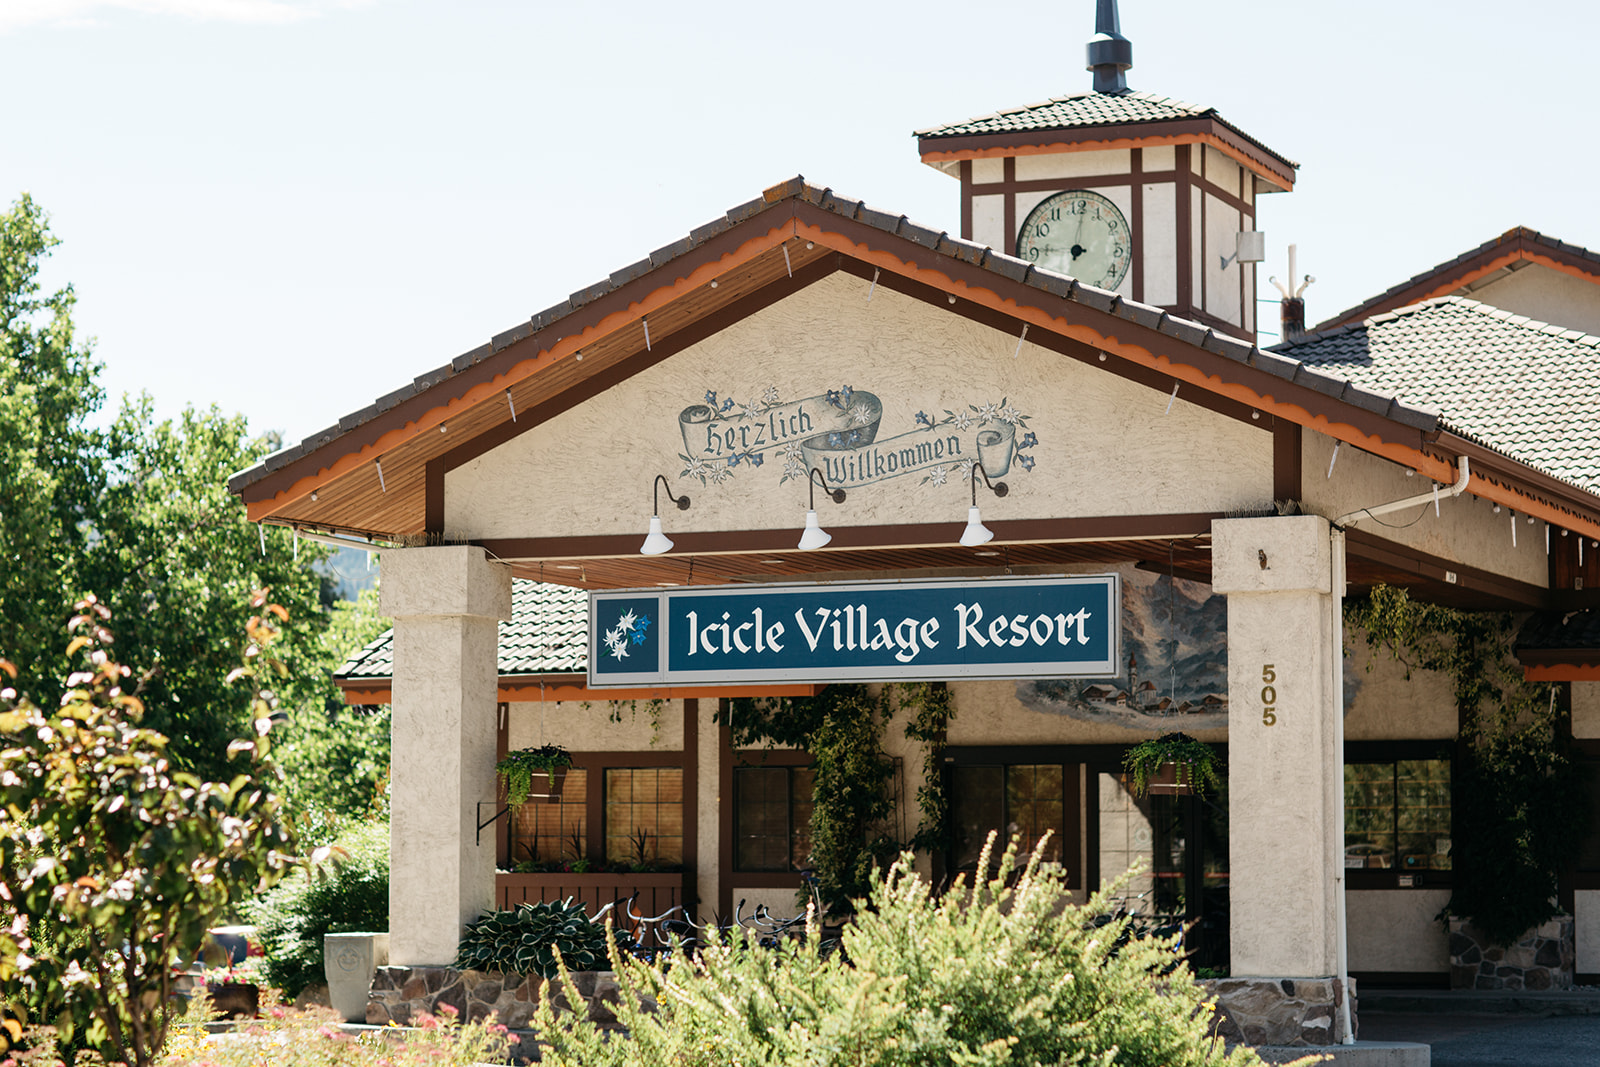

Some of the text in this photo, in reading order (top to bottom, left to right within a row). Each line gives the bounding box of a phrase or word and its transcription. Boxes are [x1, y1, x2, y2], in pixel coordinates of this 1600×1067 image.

[1047, 207, 1061, 221] 11
[1067, 200, 1087, 215] 12
[1091, 207, 1102, 221] 1
[1032, 223, 1050, 238] 10
[1029, 247, 1039, 261] 9
[1107, 263, 1118, 278] 4
[704, 405, 814, 456] Herzlich
[823, 435, 962, 484] Willkommen
[686, 601, 1092, 663] Icicle Village Resort
[1261, 664, 1277, 727] 505
